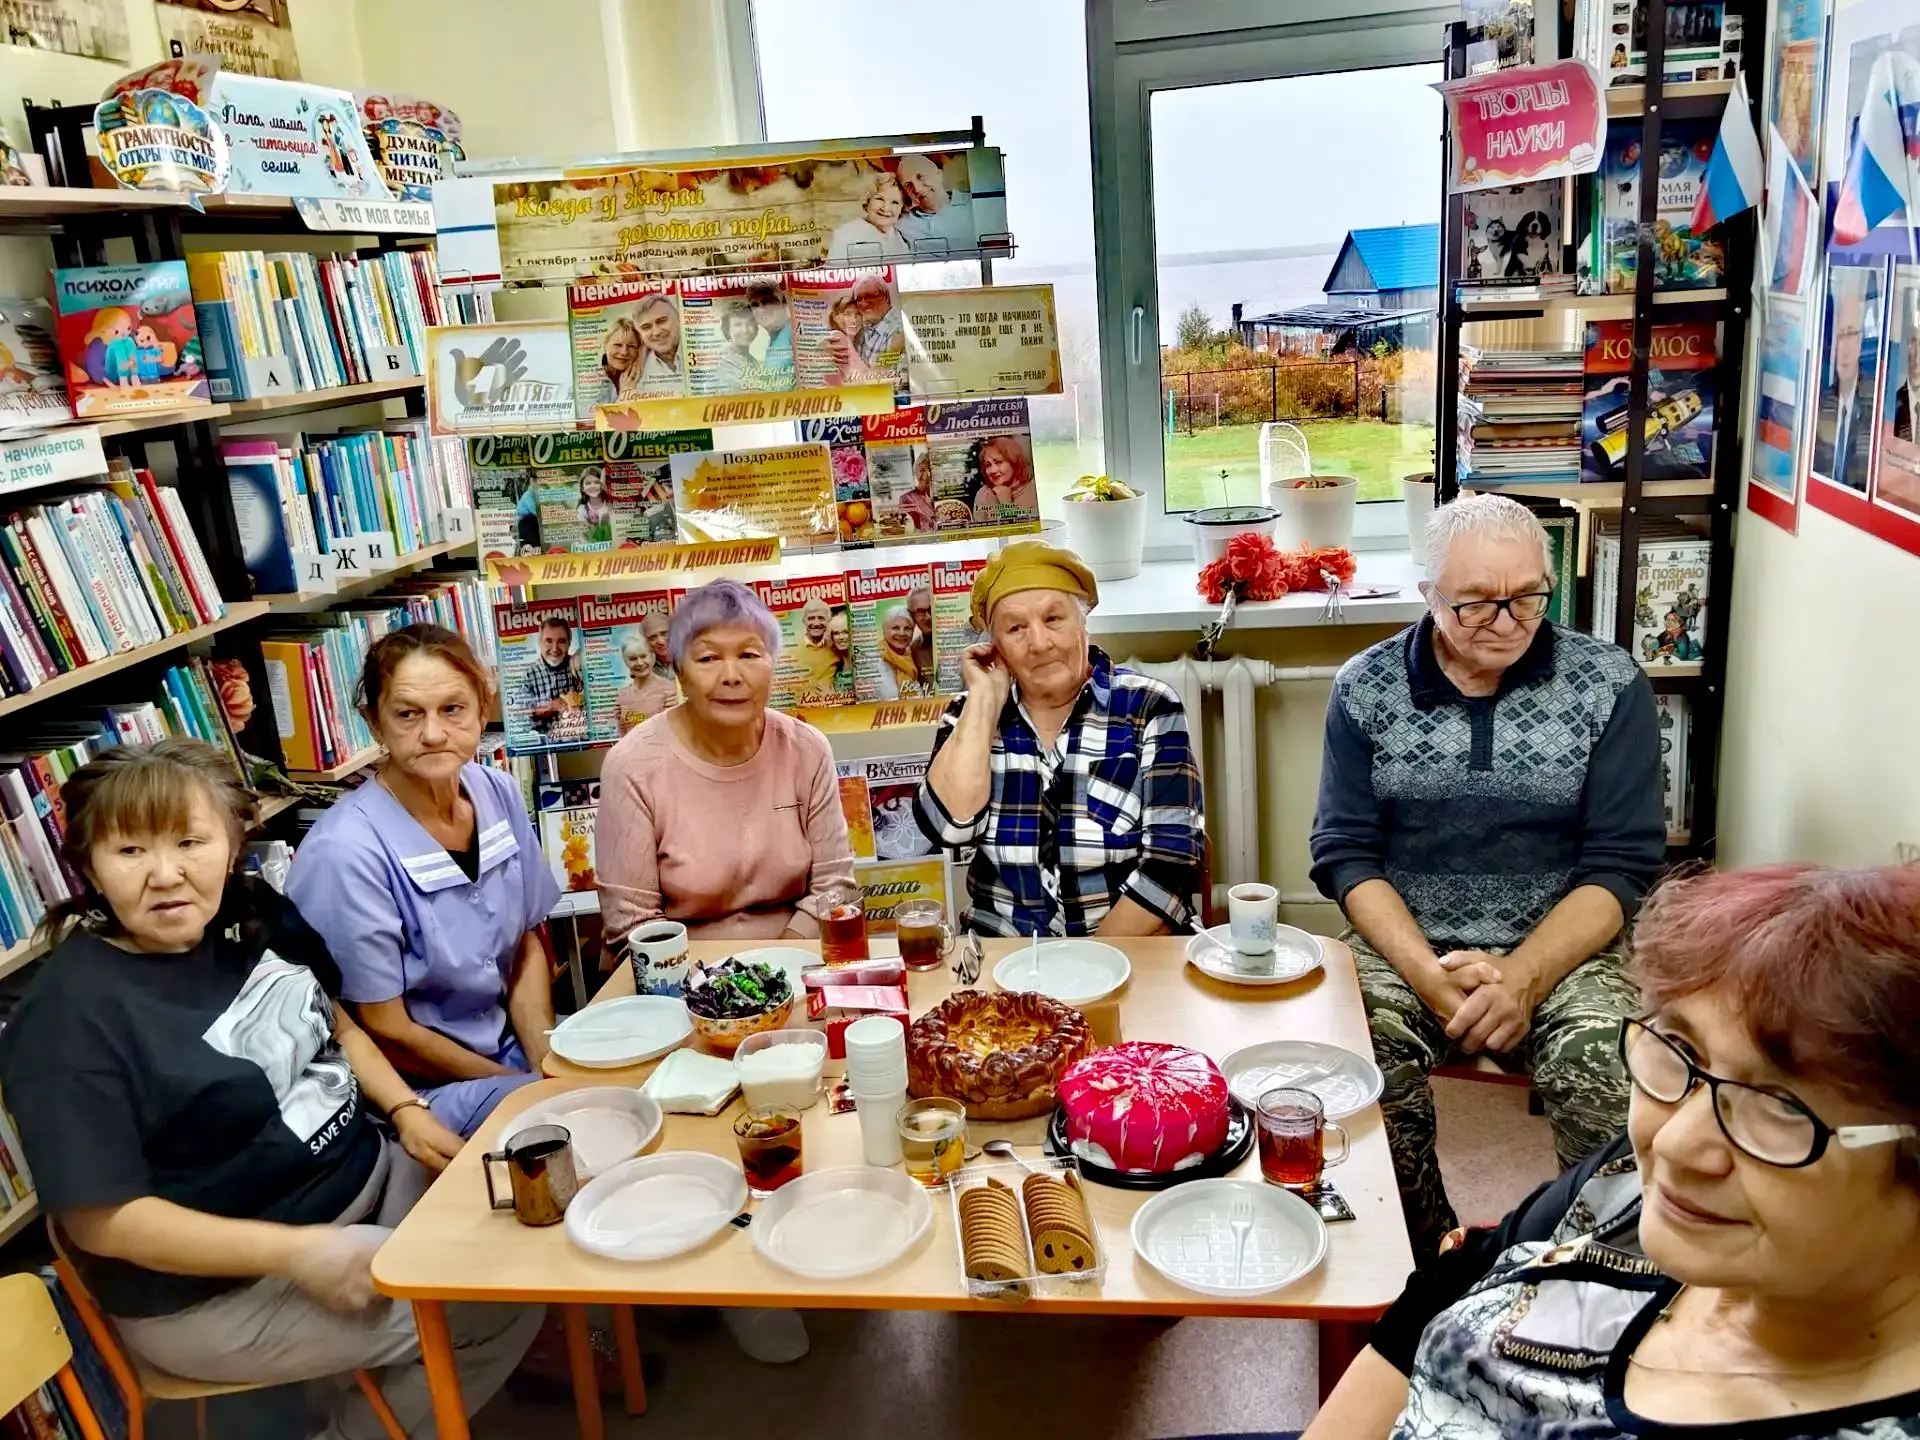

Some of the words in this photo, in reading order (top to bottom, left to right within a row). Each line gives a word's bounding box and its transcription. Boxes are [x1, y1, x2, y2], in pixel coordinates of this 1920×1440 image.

[1473, 80, 1570, 120] ТВОРЦЫ
[113, 126, 216, 158] ГРАМОТНОСТЬ
[386, 135, 438, 154] ДУМАЙ
[1487, 121, 1565, 160] НАУКИ
[261, 160, 301, 175] семья
[515, 196, 593, 225] Когда
[600, 194, 618, 221] у
[624, 182, 705, 216] жизни
[336, 203, 363, 224] Это
[366, 205, 390, 225] моя
[394, 207, 431, 226] семья
[617, 218, 722, 252] золотая
[911, 314, 945, 326] СТАРОСТЬ
[958, 313, 972, 324] ЭТО
[974, 312, 999, 324] КОГДА
[1002, 309, 1041, 321] НАЧИНАЮТ
[1020, 323, 1027, 334] Я
[1033, 322, 1044, 333] НЕ
[979, 338, 997, 348] СЕБЯ
[1020, 335, 1044, 347] ТАКИМ
[1601, 335, 1701, 360] КОМОС
[387, 354, 400, 370] Б
[266, 370, 281, 387] А
[702, 402, 770, 425] СТАРОСТЬ
[775, 401, 787, 419] В
[790, 393, 845, 419] РАДОСТЬ
[976, 403, 998, 415] ДЛЯ
[998, 401, 1024, 412] СЕБЯ
[944, 411, 1021, 431] Любимой
[4, 437, 85, 464] начинается
[631, 440, 702, 457] ЛЕКАРЬ
[722, 444, 825, 466] Поздравляем!
[10, 459, 53, 485] детей
[449, 517, 463, 532] Л
[332, 548, 359, 570] Ж
[367, 543, 383, 559] И
[541, 558, 578, 580] ПУТЬ
[580, 558, 590, 577] К
[593, 552, 668, 579] ЗДОРОВЬЮ
[671, 551, 682, 570] И
[683, 543, 775, 572] ДОЛГОЛЕТИЮ
[308, 562, 325, 581] Д
[1639, 568, 1650, 581] Я
[1651, 567, 1706, 580] ПОЗНАЮ
[1656, 579, 1685, 591] МИР
[91, 576, 126, 639] УСПЕНСКИЙ
[587, 672, 595, 683] 5
[506, 691, 515, 706] 5
[801, 692, 823, 705] Как
[870, 706, 907, 730] ДЕНЬ
[310, 1121, 341, 1156] SAVE
